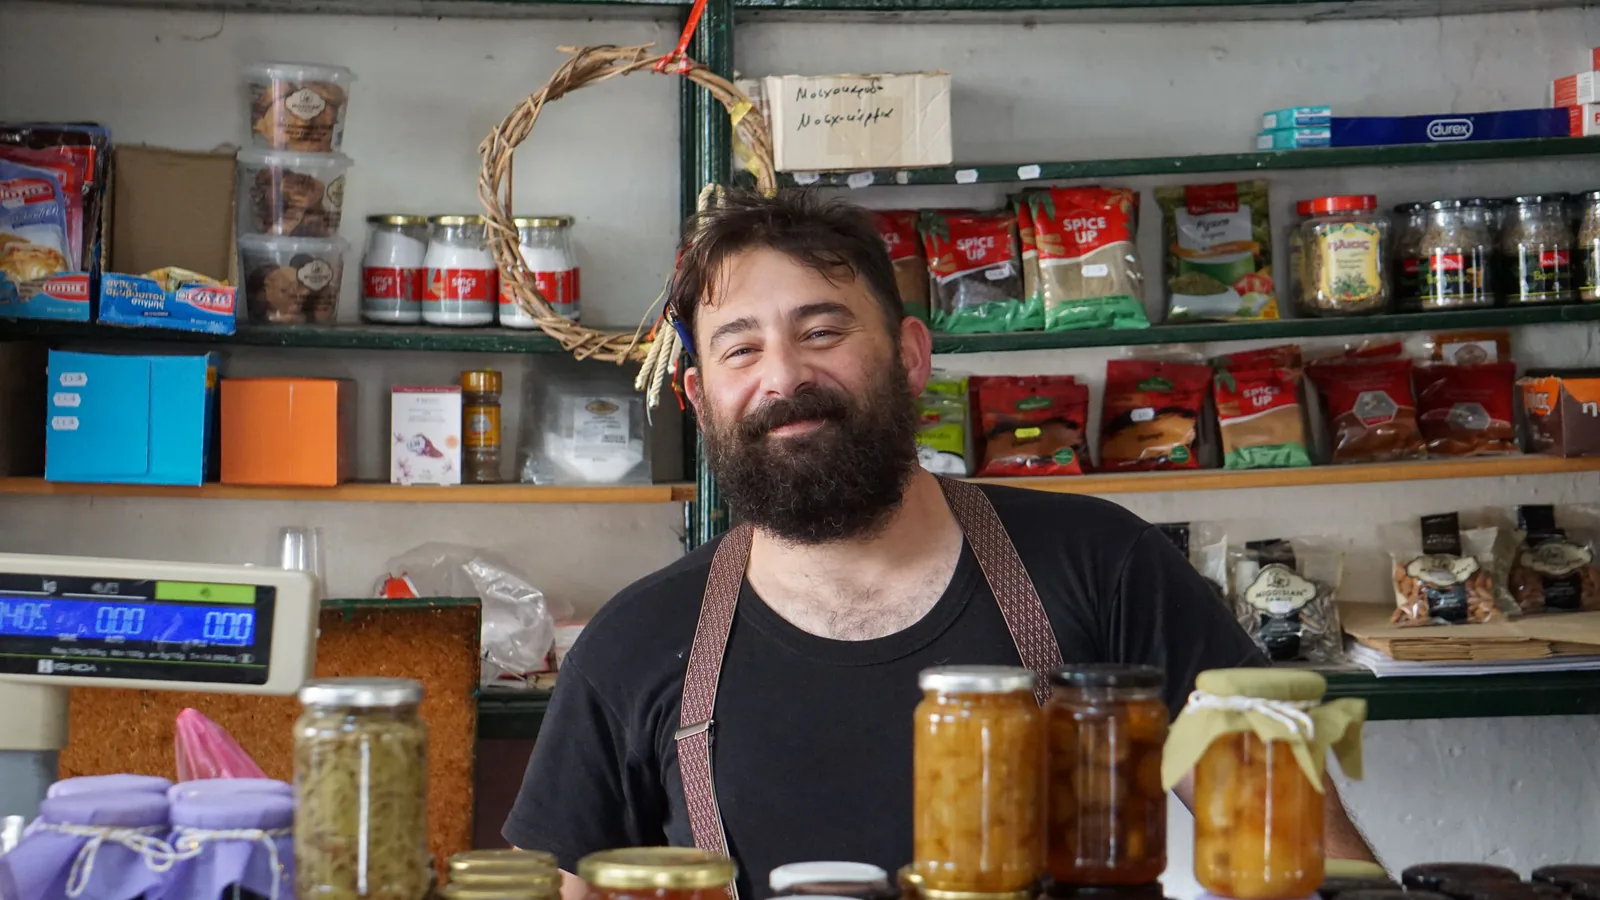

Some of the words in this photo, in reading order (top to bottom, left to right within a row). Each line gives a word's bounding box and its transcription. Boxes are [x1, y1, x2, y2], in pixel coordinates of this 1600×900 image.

[1431, 122, 1469, 136] durex
[1063, 216, 1107, 232] SPICE
[1075, 230, 1098, 244] UP
[957, 236, 994, 251] SPICE
[966, 248, 987, 260] UP
[371, 276, 392, 285] SPICE
[452, 277, 477, 287] SPICE
[375, 284, 387, 293] UP
[457, 285, 472, 295] UP
[1243, 385, 1281, 399] SPICE
[1252, 395, 1273, 407] UP
